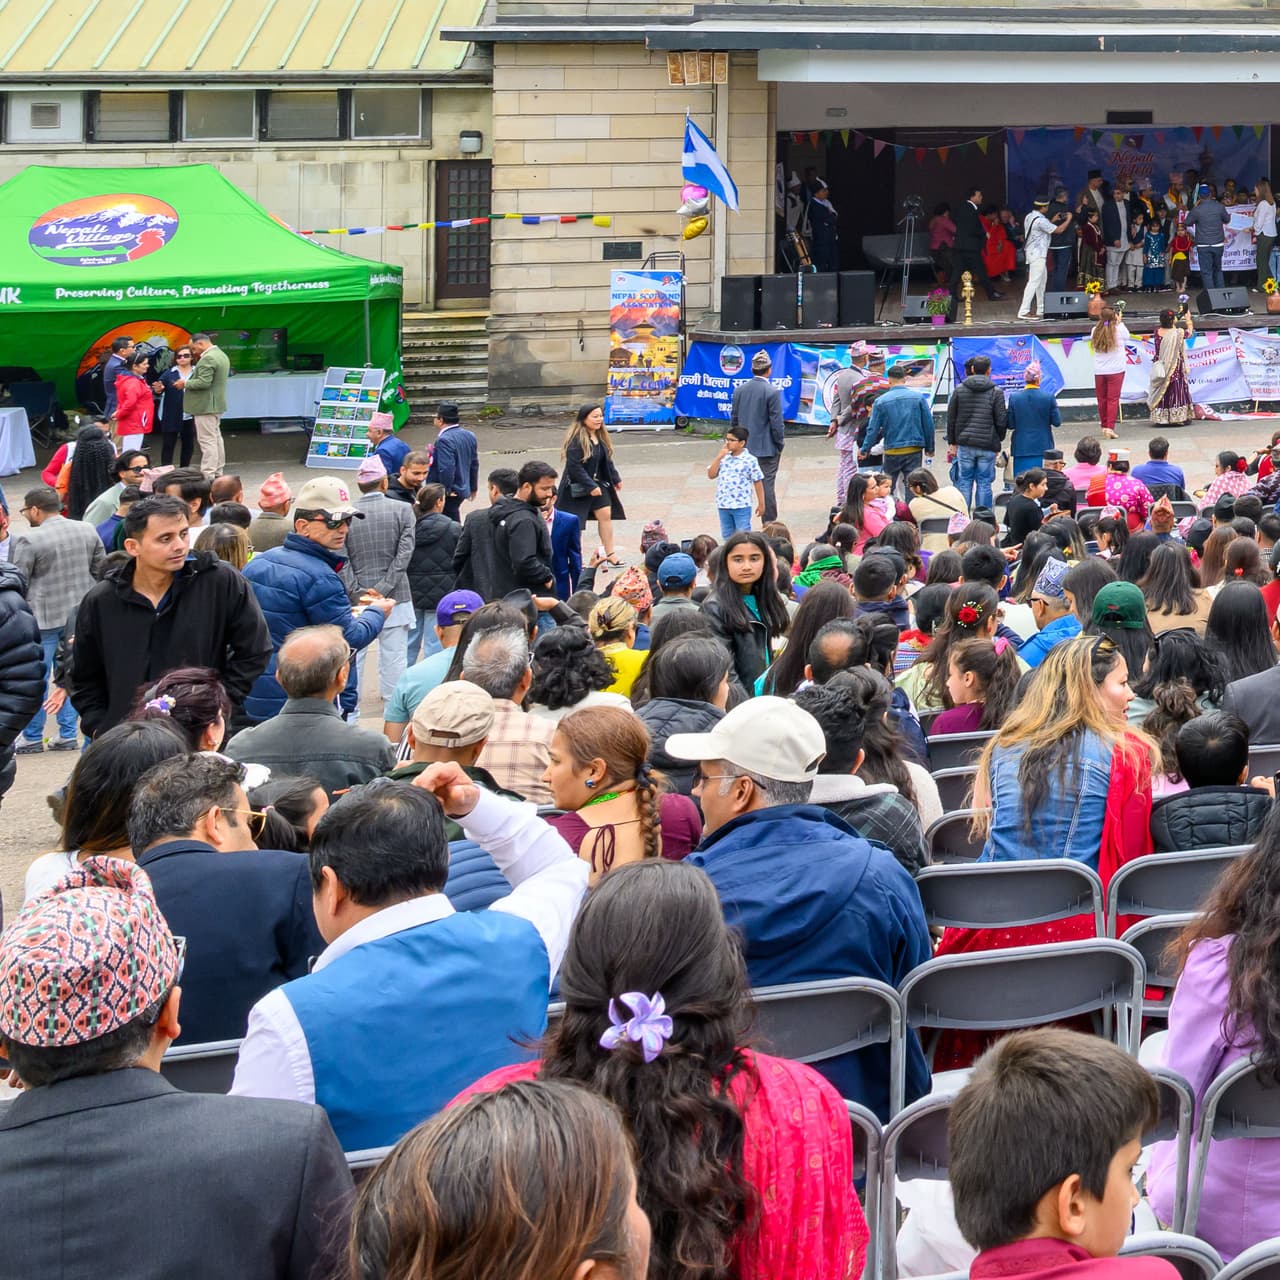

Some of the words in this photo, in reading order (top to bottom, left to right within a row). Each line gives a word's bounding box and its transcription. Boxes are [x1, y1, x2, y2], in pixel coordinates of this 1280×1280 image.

[45, 223, 109, 236] Nepali
[66, 232, 136, 245] Village
[55, 287, 123, 300] Preserving
[126, 285, 179, 299] Culture,
[182, 284, 248, 297] Promoting
[251, 280, 330, 296] Togetherness
